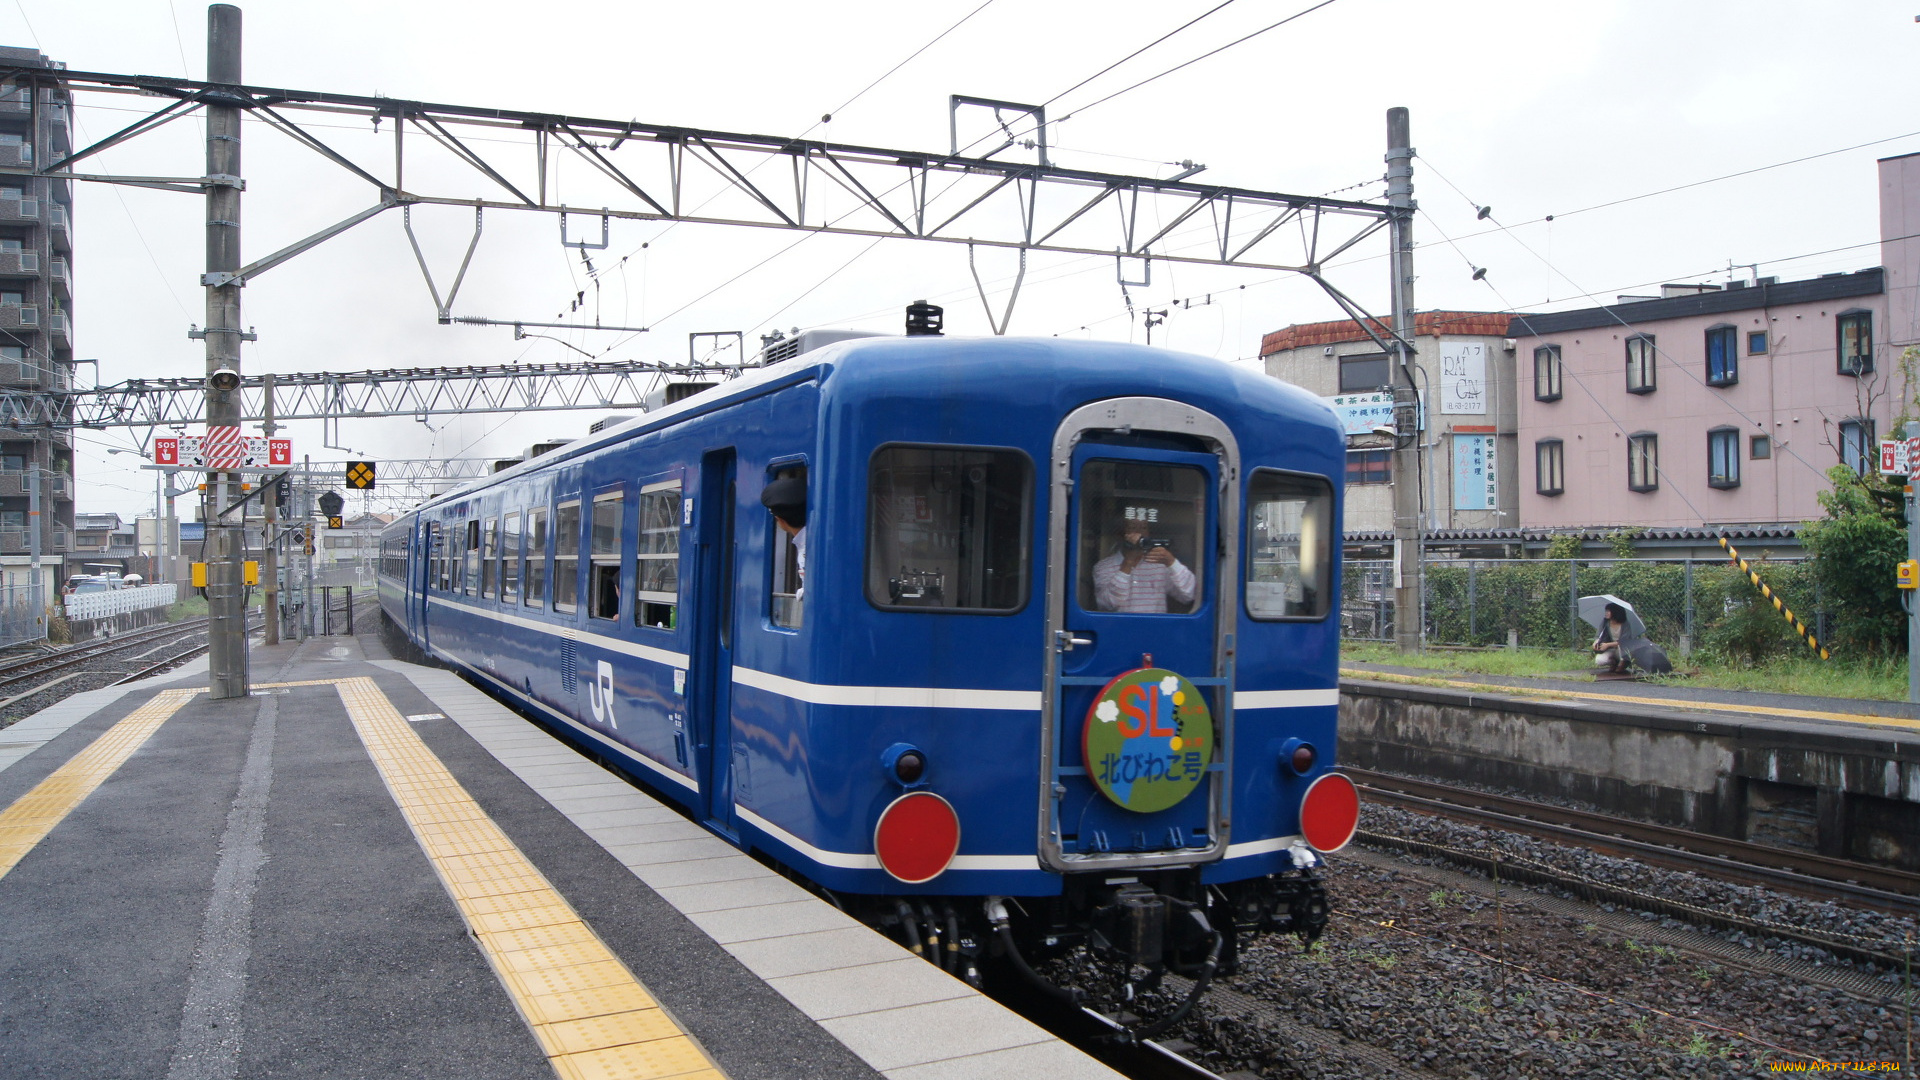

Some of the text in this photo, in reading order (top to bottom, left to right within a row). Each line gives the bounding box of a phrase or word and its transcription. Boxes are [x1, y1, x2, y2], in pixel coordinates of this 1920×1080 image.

[1348, 406, 1393, 417] 沖縄料理
[157, 441, 176, 449] SOS
[271, 442, 289, 450] SOS
[1883, 446, 1894, 454] SOS
[1473, 437, 1482, 476] 沖縄料理
[589, 659, 617, 730] JR
[1117, 684, 1175, 739] SL
[1098, 751, 1203, 785] 北びわこ号
